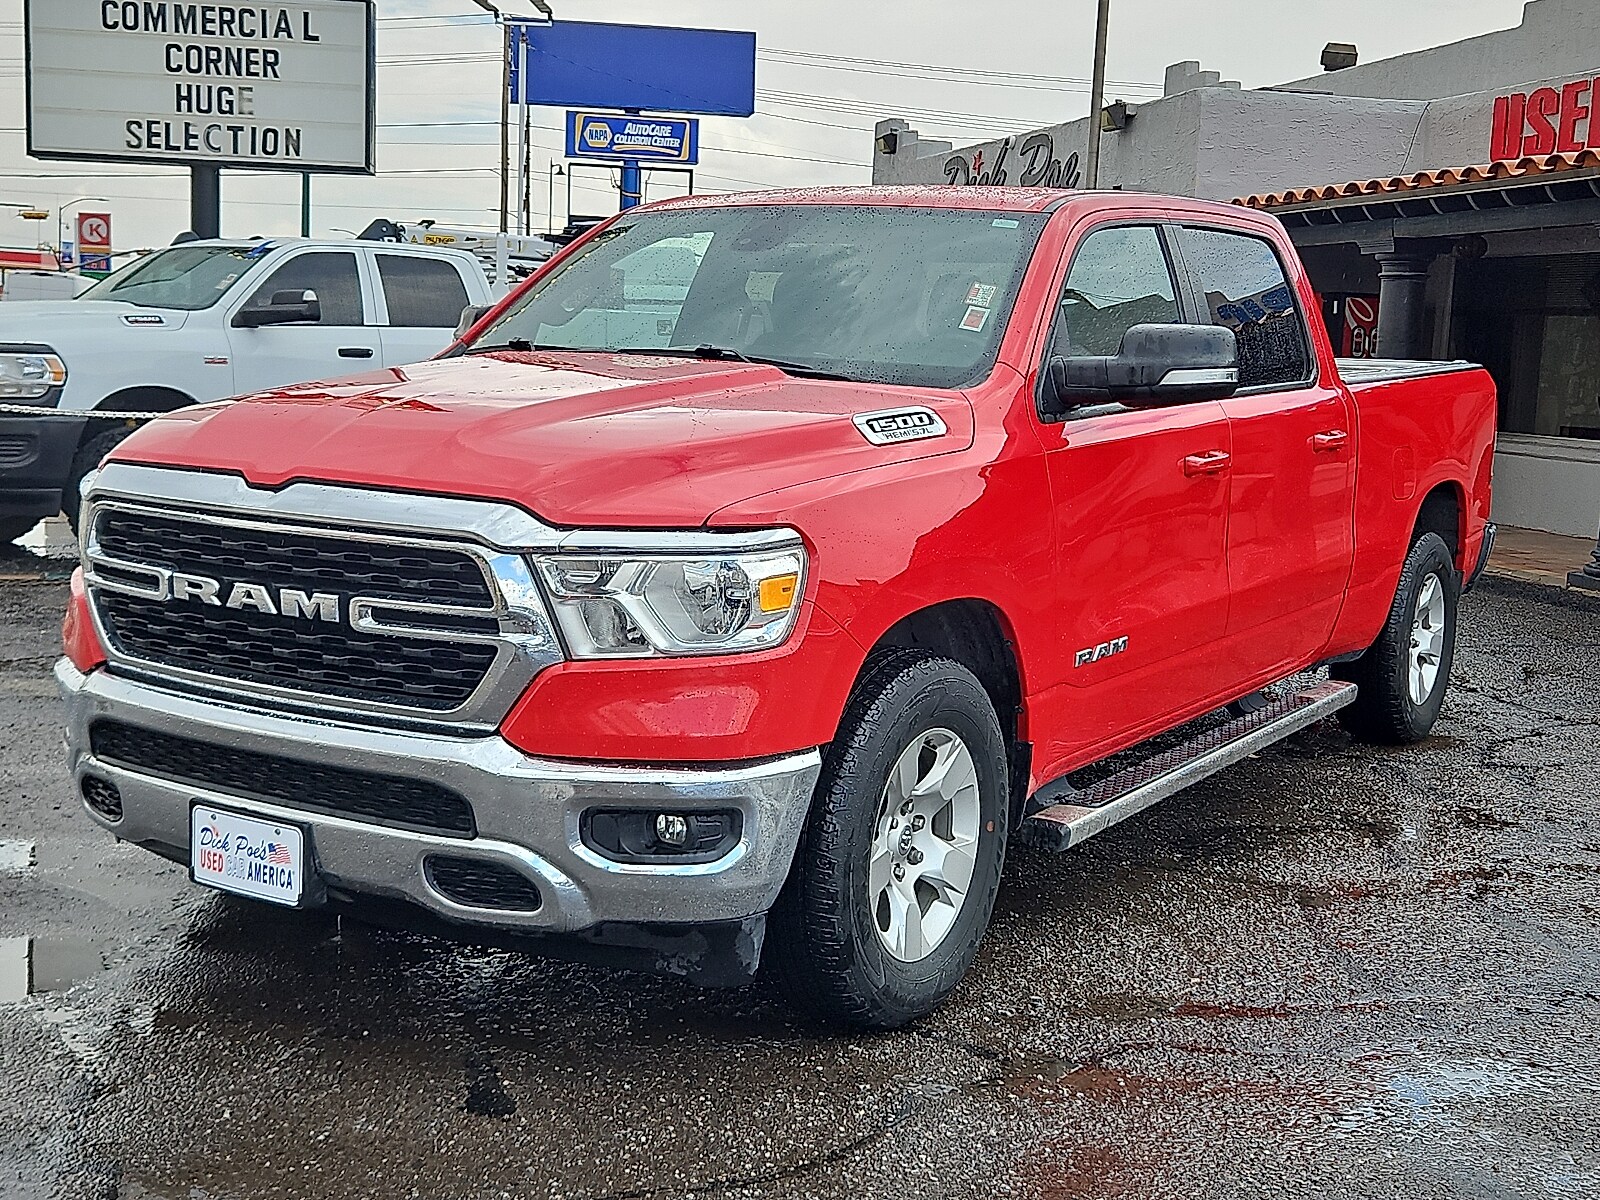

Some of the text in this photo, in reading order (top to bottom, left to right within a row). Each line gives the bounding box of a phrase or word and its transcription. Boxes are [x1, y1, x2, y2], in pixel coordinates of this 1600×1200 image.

[101, 0, 321, 42] COMMERCIAL
[164, 43, 281, 79] CORNER
[174, 83, 254, 116] HUGE
[125, 120, 302, 158] SELECTION
[588, 128, 609, 142] NAPA
[613, 133, 680, 147] COLLISION CENTER
[89, 223, 106, 239] K
[868, 413, 930, 432] 1500
[883, 430, 910, 440] HEMI
[172, 572, 340, 624] RAM
[1074, 635, 1129, 668] RAM
[200, 826, 268, 861] Dick Poe's
[200, 848, 225, 873] USED
[247, 861, 294, 890] AMERICA
